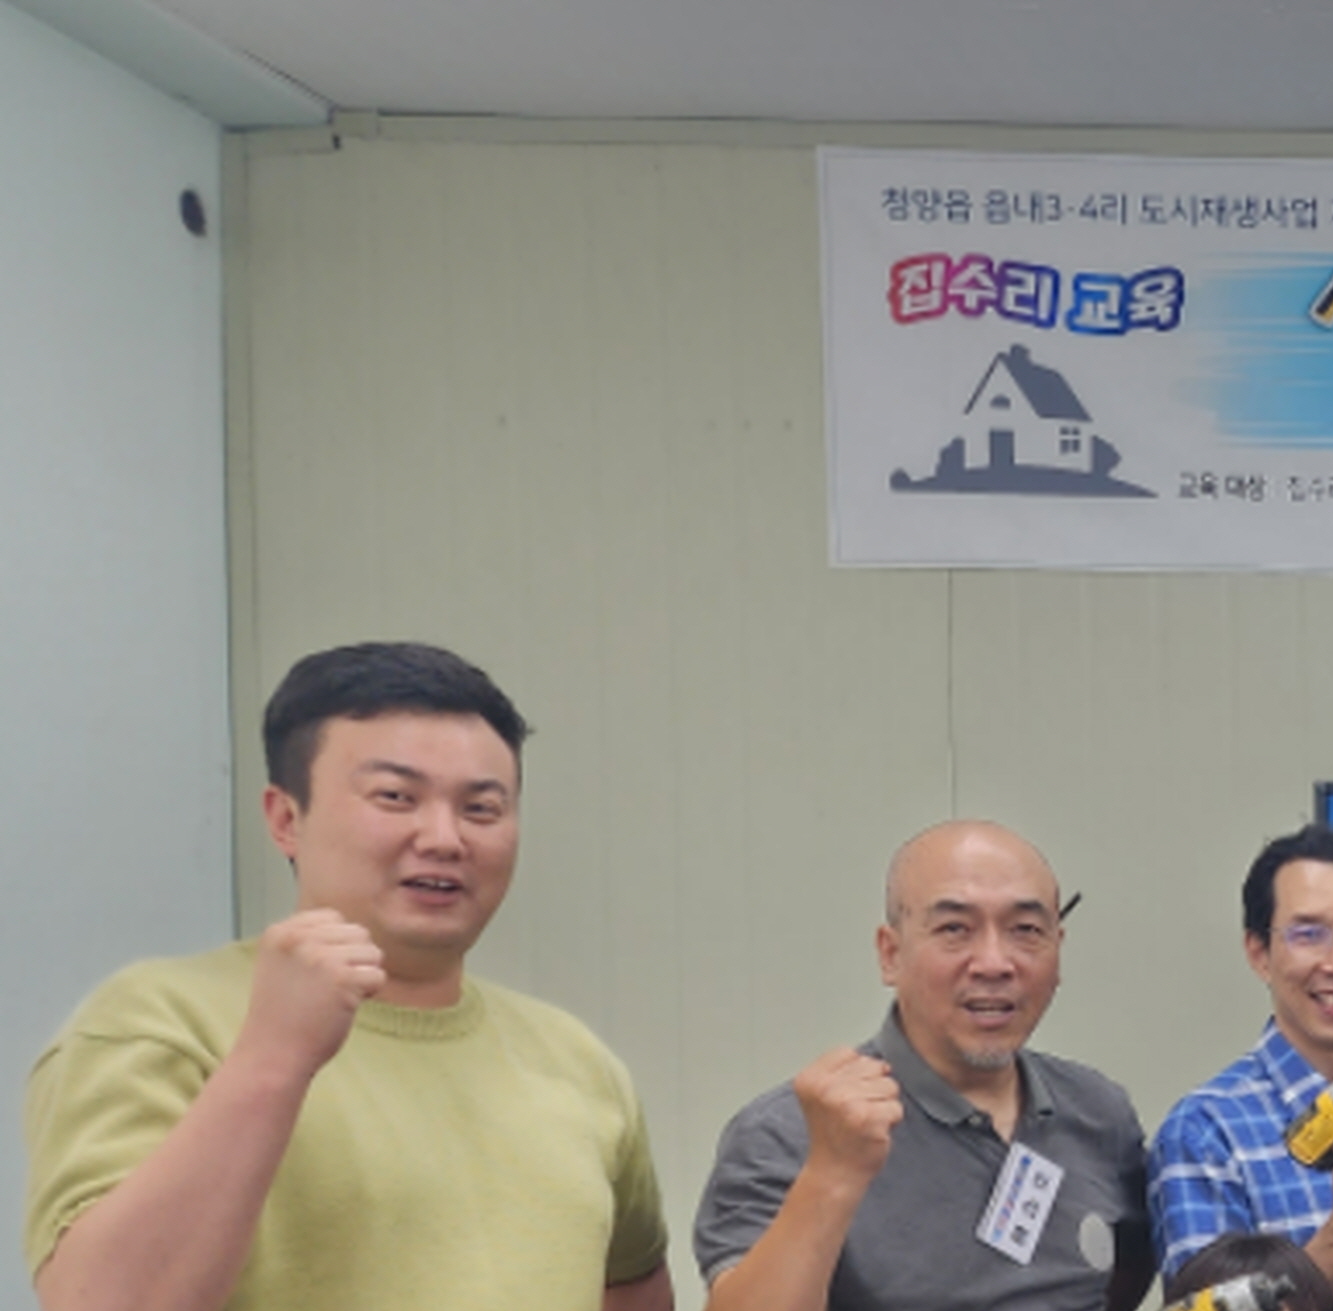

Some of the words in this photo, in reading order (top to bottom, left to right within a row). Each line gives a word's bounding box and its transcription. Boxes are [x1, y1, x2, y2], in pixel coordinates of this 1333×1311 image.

[881, 187, 973, 223] 청양읍
[1138, 196, 1318, 230] 도시재생사업
[889, 253, 1060, 328] 집수리
[1066, 266, 1184, 336] 교육
